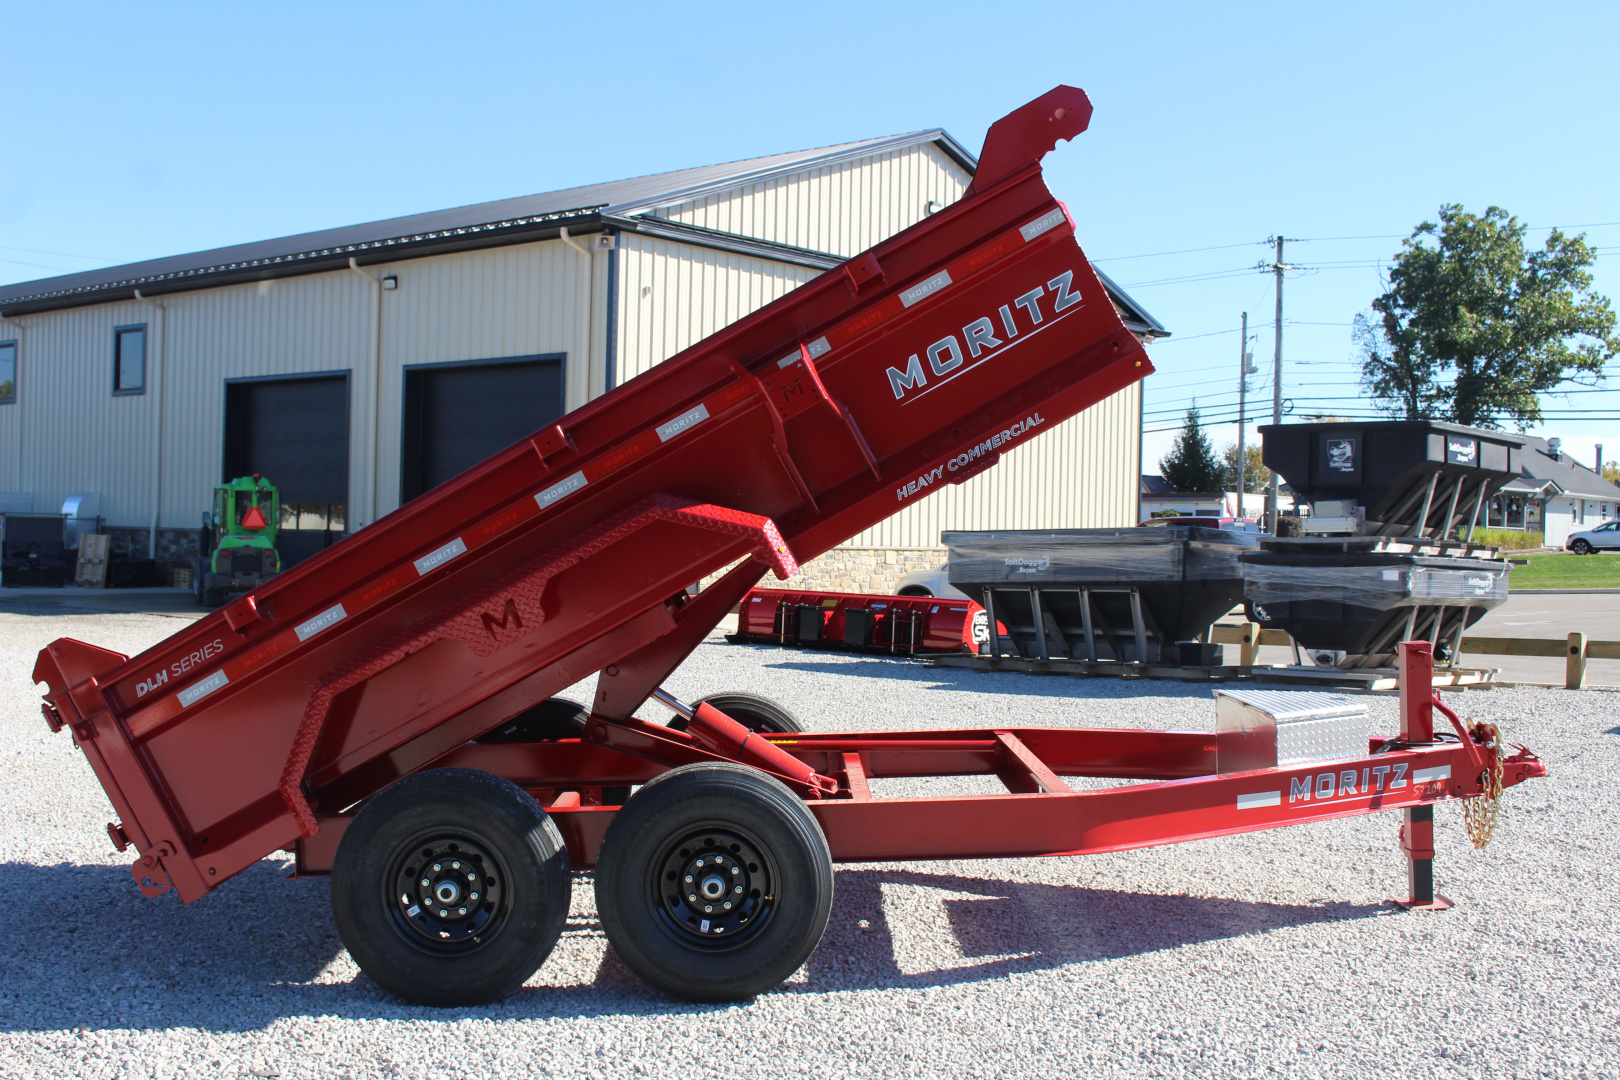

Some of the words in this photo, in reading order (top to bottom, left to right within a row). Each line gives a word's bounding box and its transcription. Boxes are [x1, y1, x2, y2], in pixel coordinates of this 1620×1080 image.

[1028, 211, 1063, 235] MORITZ
[968, 244, 1004, 268] MORITZ
[908, 277, 943, 301] MORITZ
[847, 310, 883, 333] MORITZ
[886, 269, 1083, 399] MORITZ
[725, 382, 751, 401] MORI
[665, 411, 701, 435] MORITZ
[604, 444, 640, 468] MORITZ
[896, 465, 944, 501] HEAVY
[947, 412, 1045, 472] COMMERCIAL
[543, 478, 579, 502] MORITZ
[482, 511, 518, 535] MORITZ
[422, 544, 458, 568] MORITZ
[362, 578, 398, 601] MORITZ
[303, 611, 338, 635] MORITZ
[480, 597, 524, 643] M
[975, 614, 988, 625] BOS
[136, 669, 169, 698] DLH
[171, 638, 224, 677] SERIES
[185, 677, 221, 701] MORITZ
[1289, 762, 1409, 803] MORITZ
